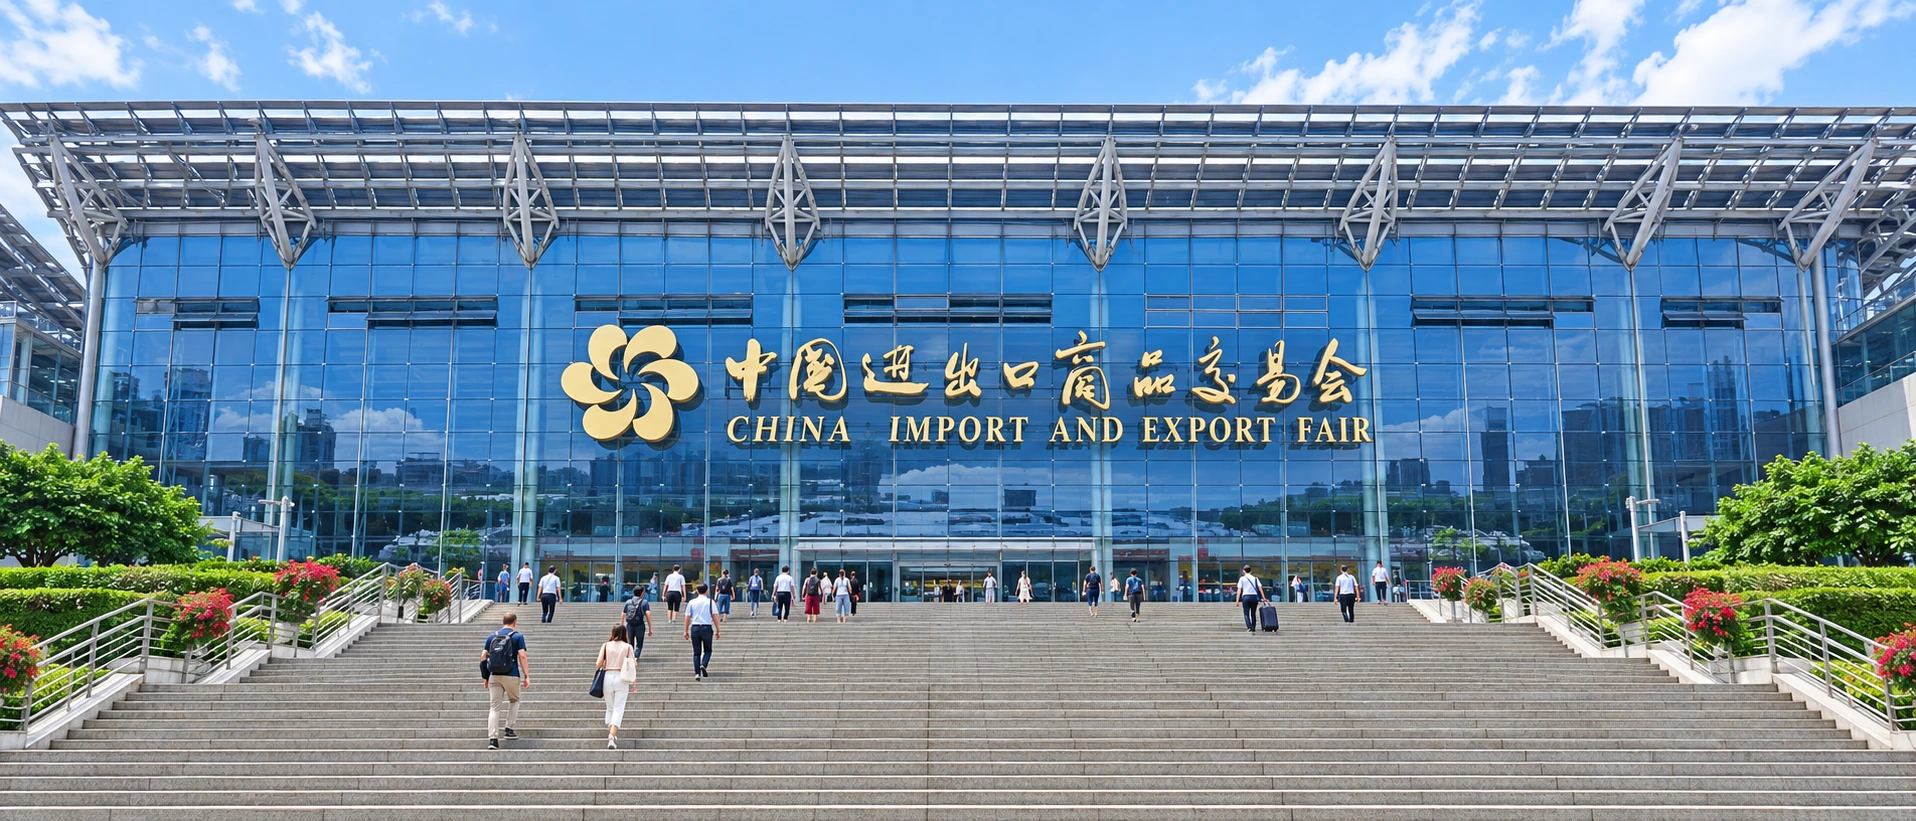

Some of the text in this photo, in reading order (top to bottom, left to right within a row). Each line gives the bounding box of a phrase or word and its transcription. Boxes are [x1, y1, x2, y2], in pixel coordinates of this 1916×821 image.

[726, 330, 1367, 410] 中国进出口商品交易会
[727, 415, 1373, 443] CHINA IMPORT AND EXPORT FAIR
